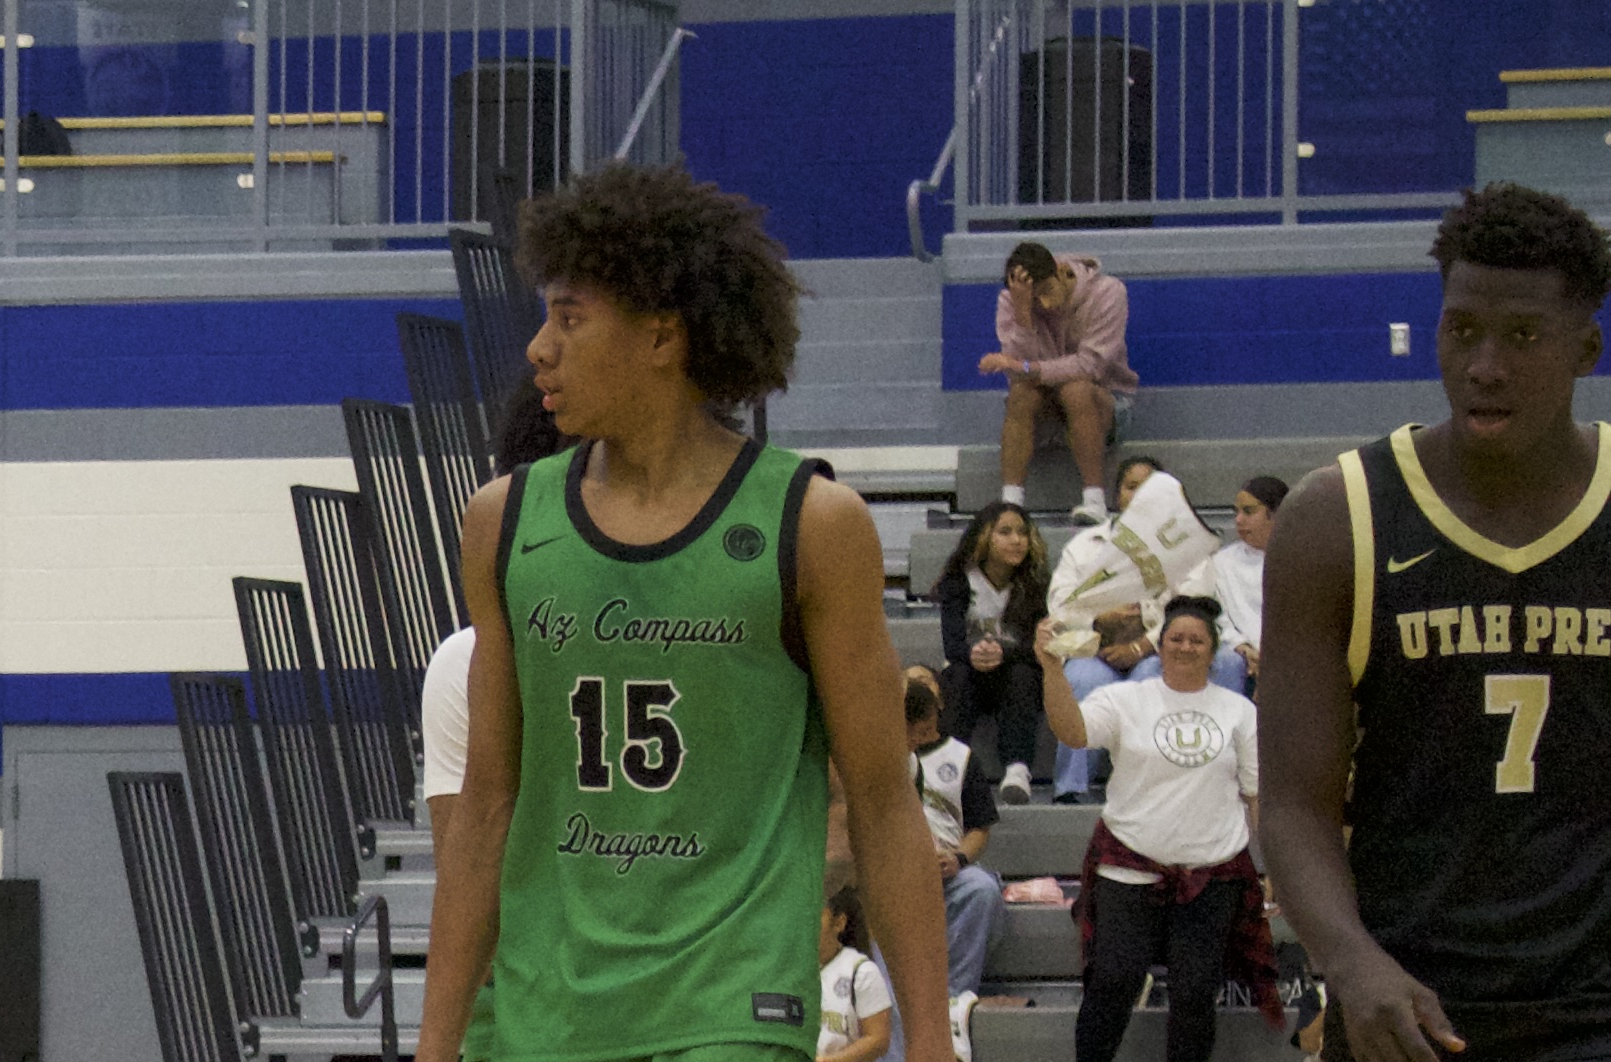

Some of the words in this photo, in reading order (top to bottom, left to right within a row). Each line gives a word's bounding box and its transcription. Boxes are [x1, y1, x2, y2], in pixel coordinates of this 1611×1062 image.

[526, 595, 578, 653] Az
[593, 598, 749, 653] Compass
[1396, 605, 1512, 660] UTAH
[569, 676, 688, 792] 15
[1484, 674, 1551, 794] 7
[557, 812, 706, 875] Dragons
